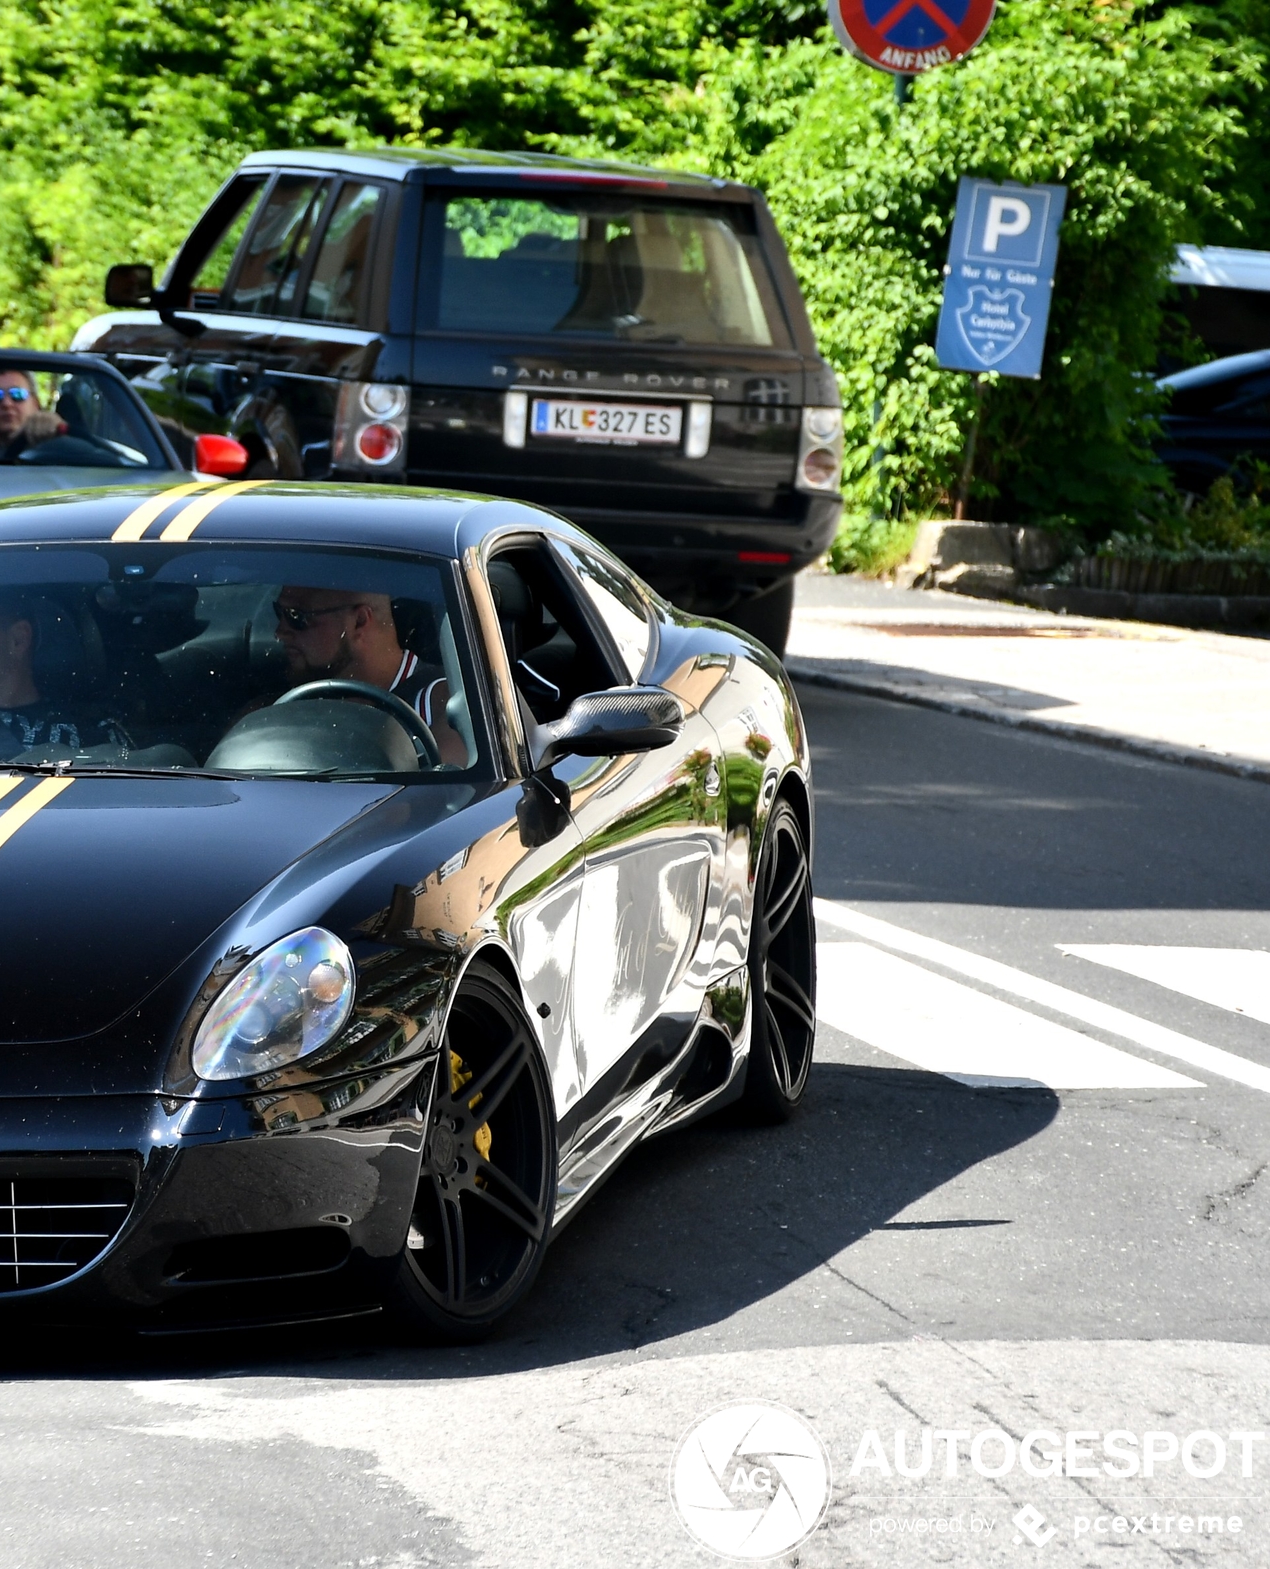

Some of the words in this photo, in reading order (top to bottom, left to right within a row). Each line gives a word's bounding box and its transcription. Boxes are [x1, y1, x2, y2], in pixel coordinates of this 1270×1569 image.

[981, 196, 1031, 253] P
[492, 366, 601, 382] RANGE
[623, 373, 731, 391] ROVER
[555, 408, 579, 430] KL
[598, 410, 639, 433] 327
[645, 413, 672, 436] ES
